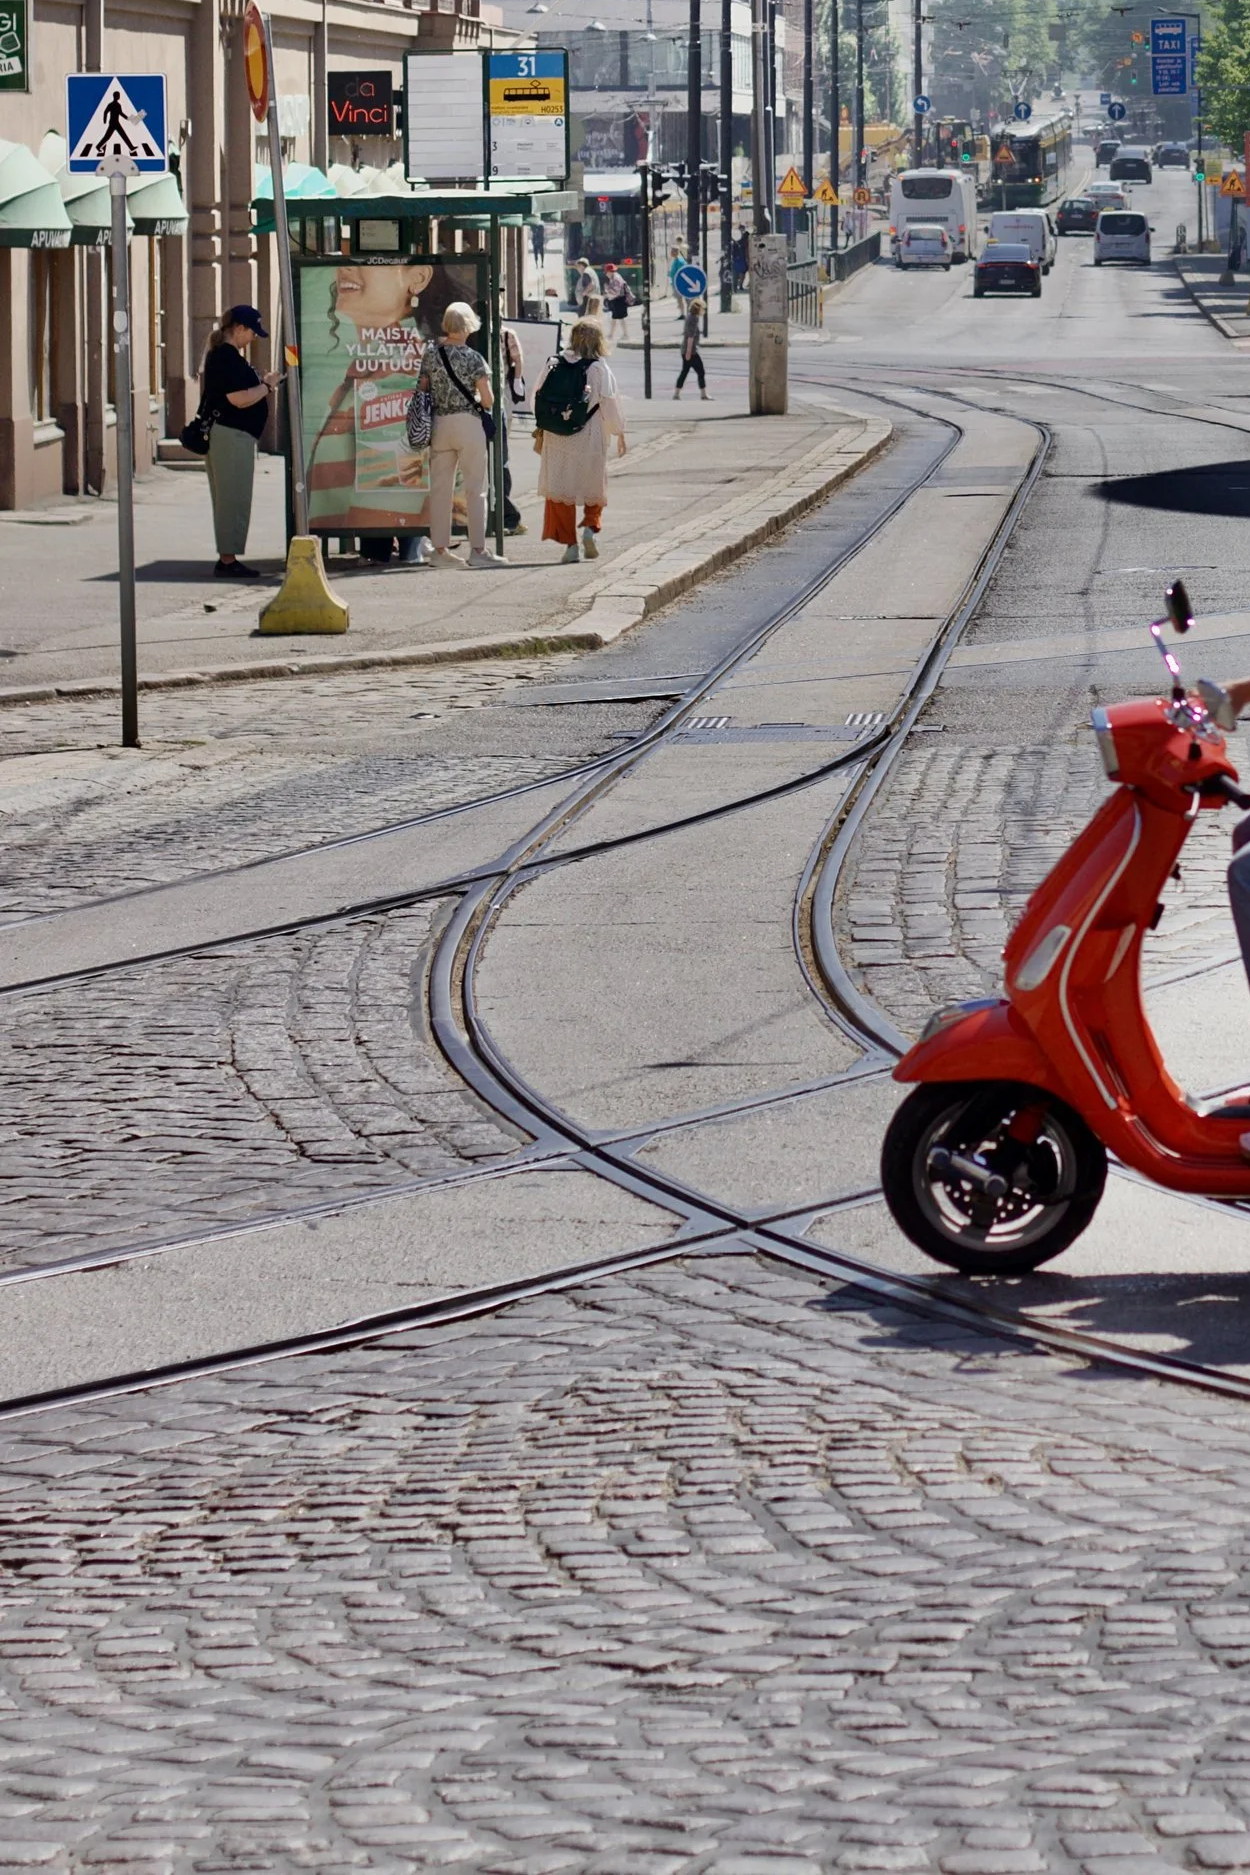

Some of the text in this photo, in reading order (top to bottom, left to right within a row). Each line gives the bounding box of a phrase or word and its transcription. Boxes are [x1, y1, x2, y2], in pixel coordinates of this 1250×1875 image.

[1158, 40, 1180, 50] TAXI
[517, 56, 536, 76] 31
[345, 75, 375, 98] da
[331, 100, 388, 123] Vinci
[541, 105, 564, 113] H0253
[492, 141, 498, 151] 3
[492, 166, 499, 175] 9
[599, 201, 607, 212] 9
[366, 257, 409, 265] JCDecaux
[361, 327, 421, 340] MAISTA
[355, 358, 422, 372] UUTUUS
